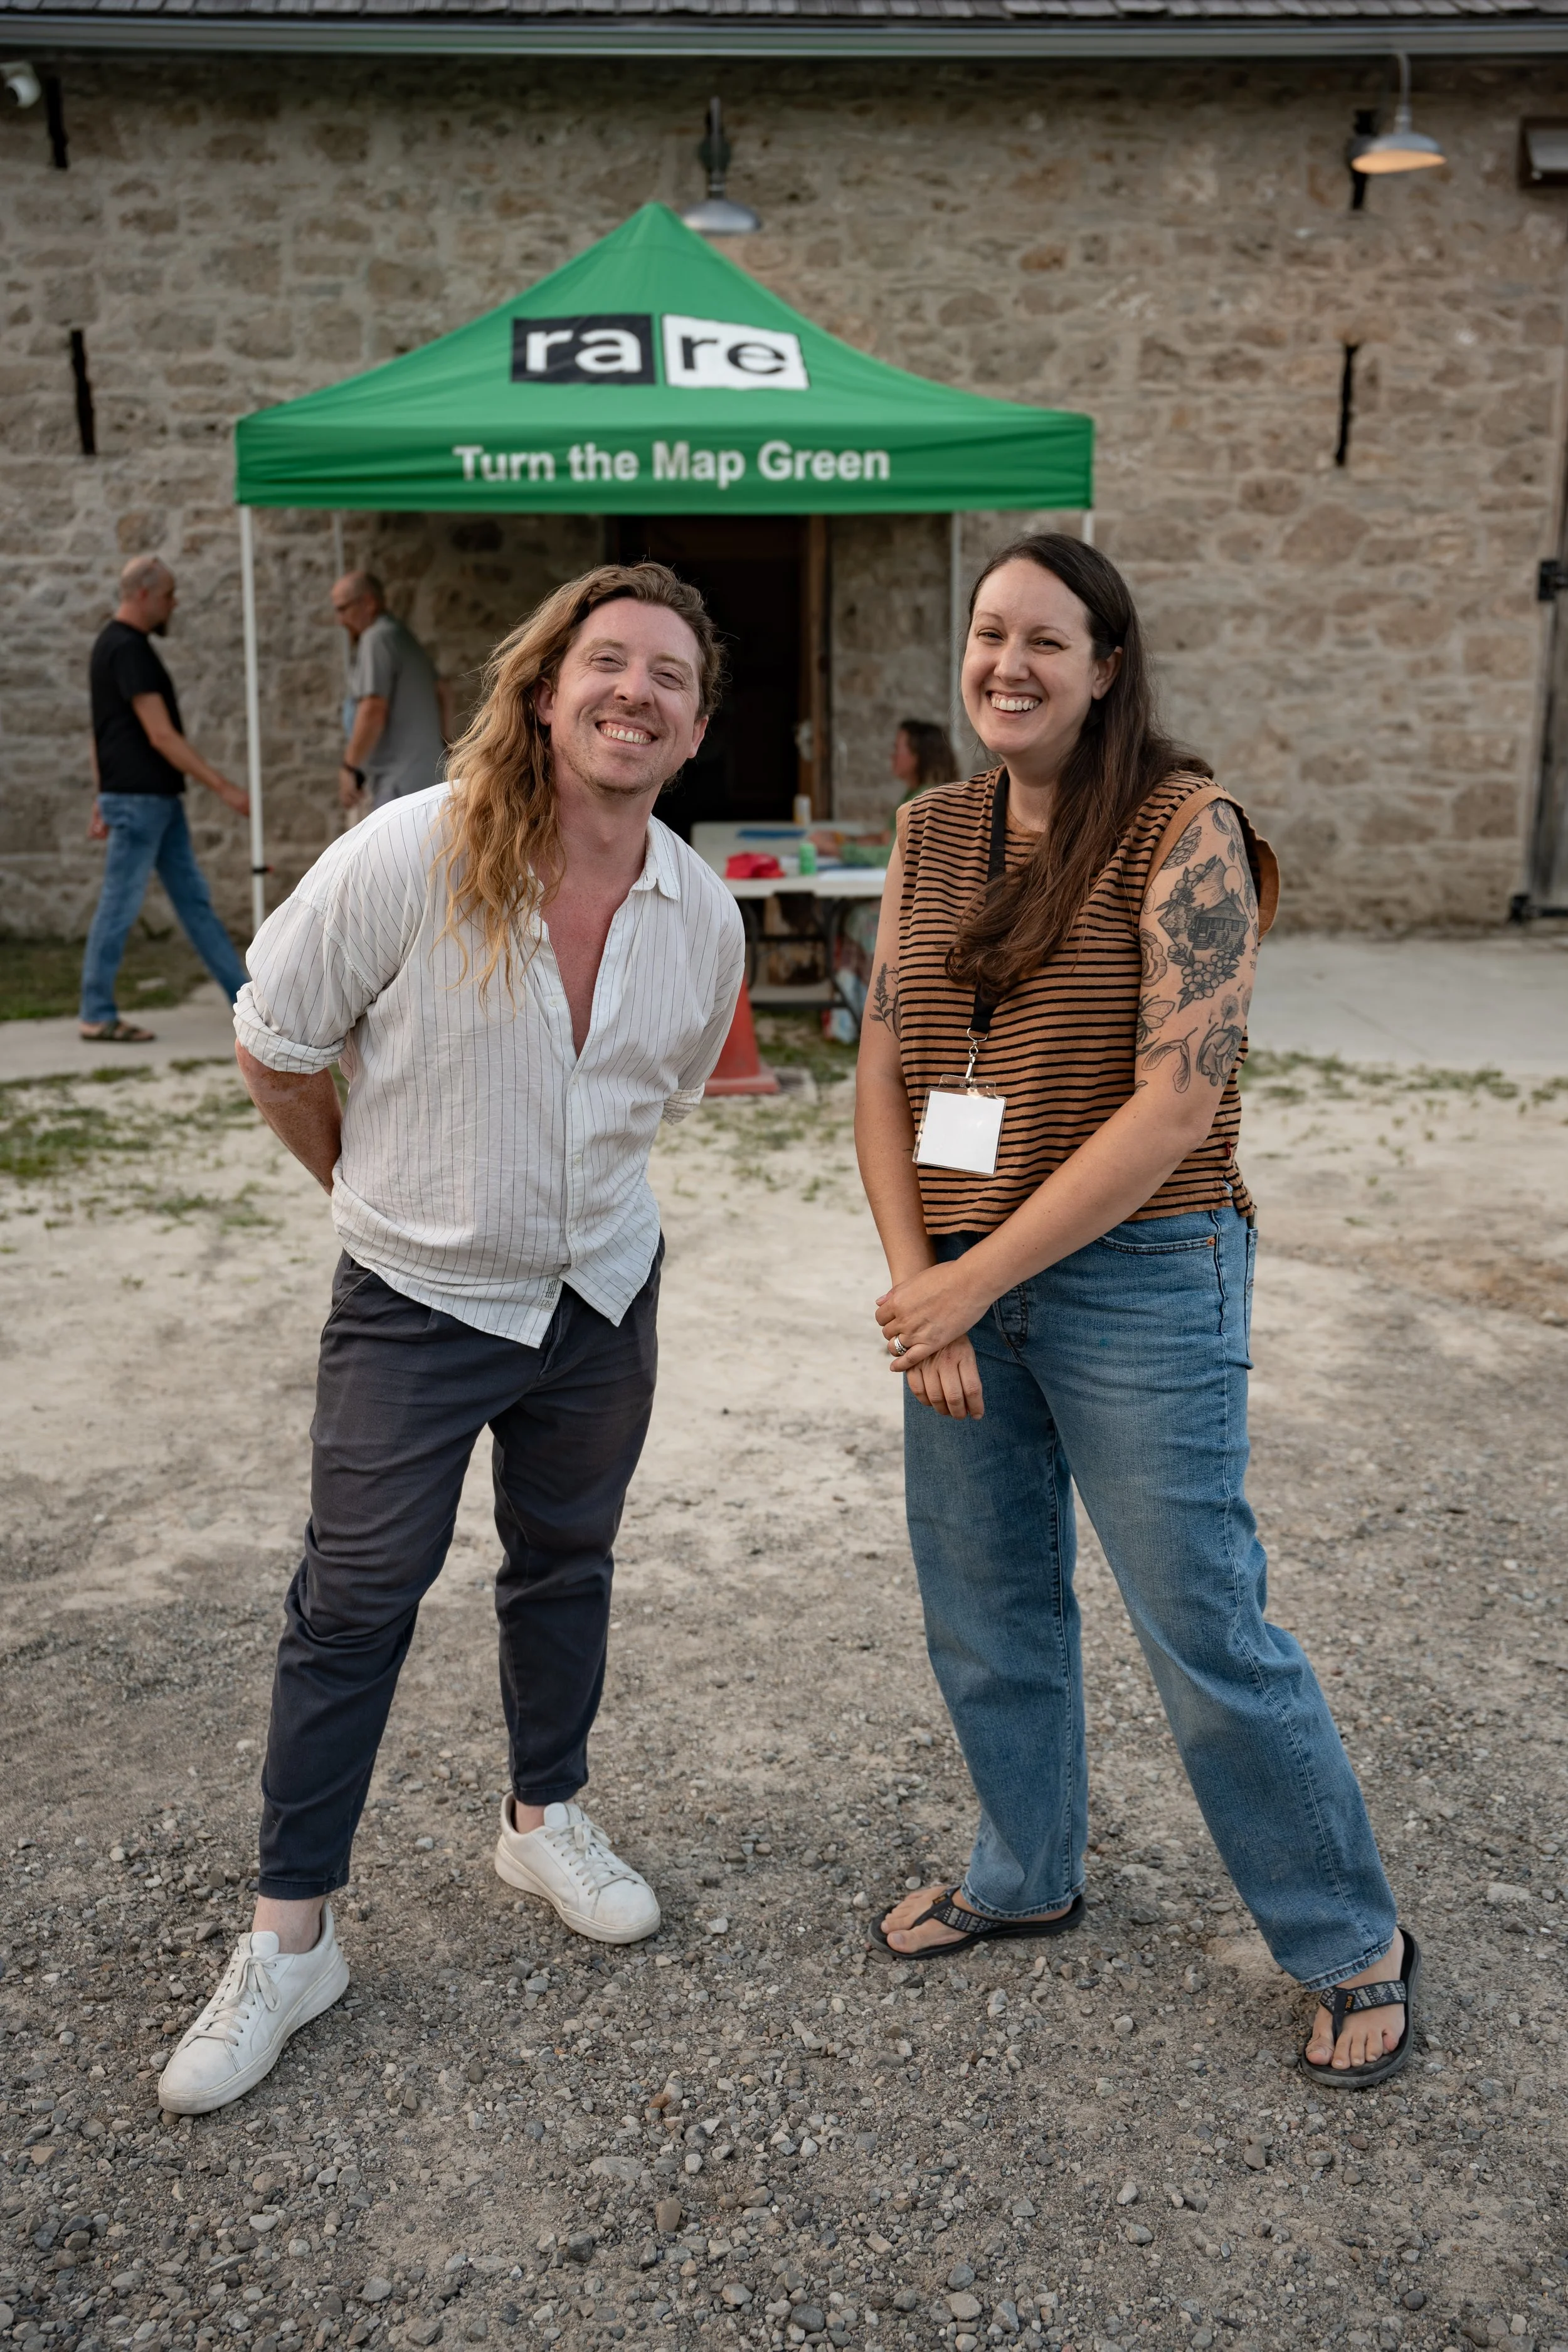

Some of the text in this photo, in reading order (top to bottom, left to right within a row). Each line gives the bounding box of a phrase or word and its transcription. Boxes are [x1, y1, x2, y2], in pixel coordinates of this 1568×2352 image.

[452, 438, 891, 490] Turn the Map Green
